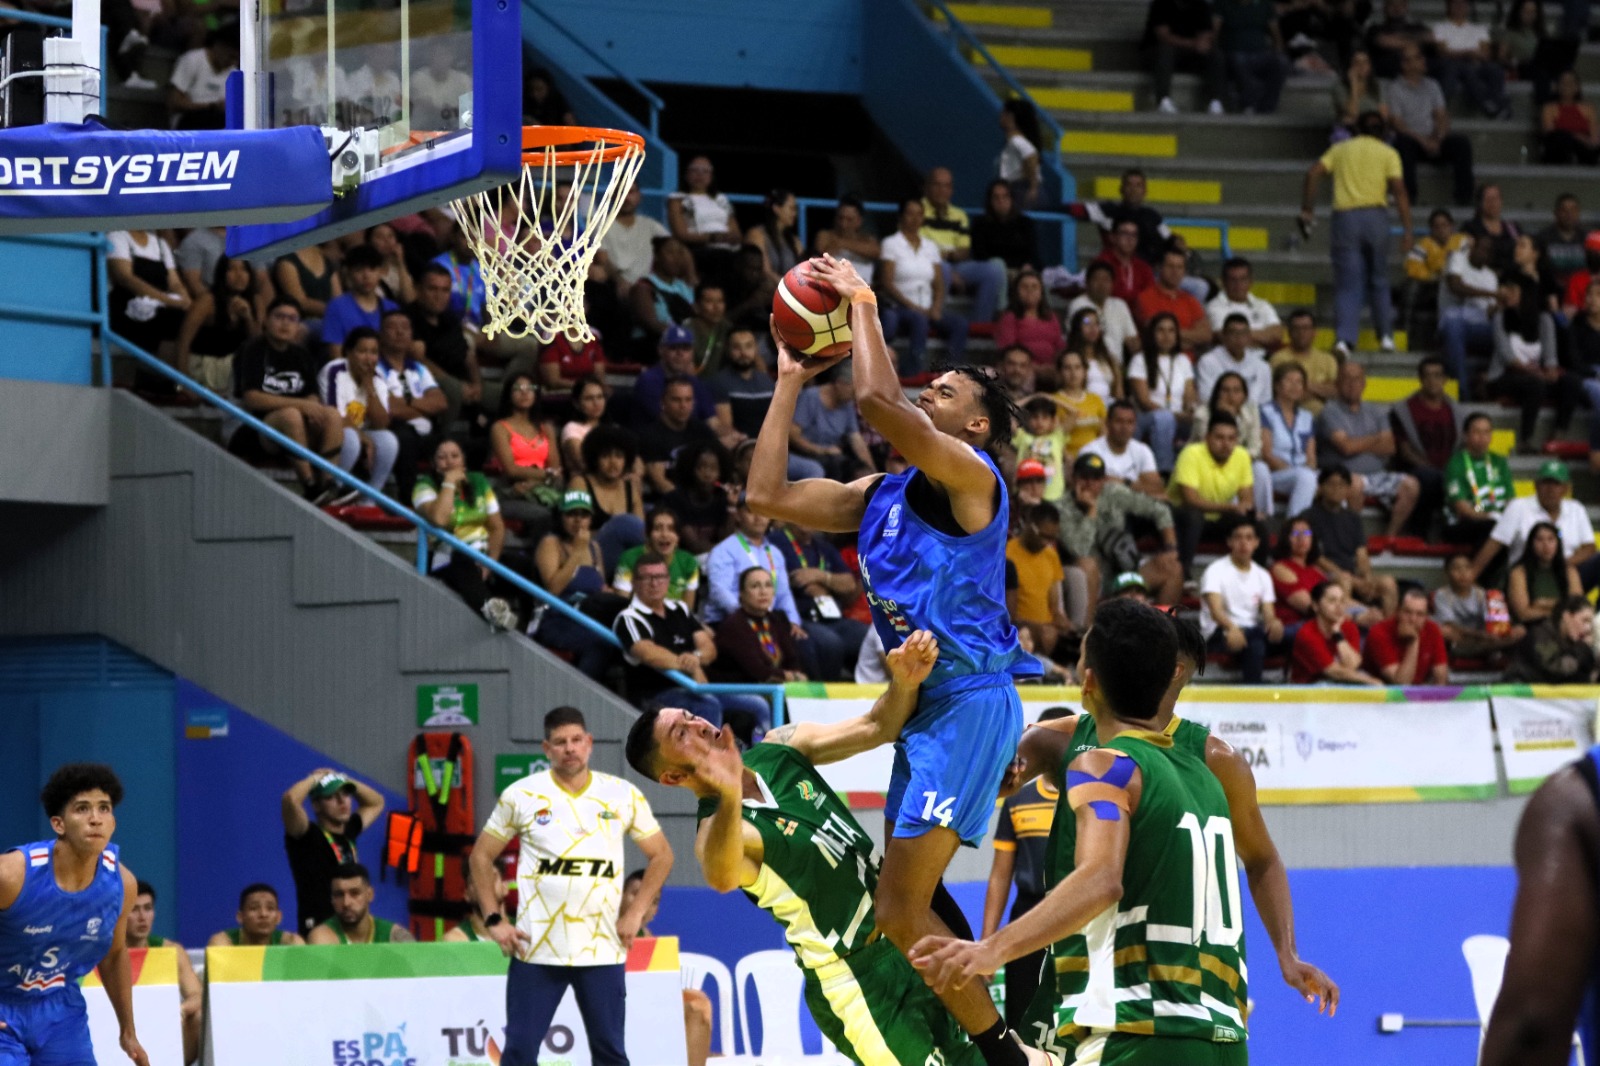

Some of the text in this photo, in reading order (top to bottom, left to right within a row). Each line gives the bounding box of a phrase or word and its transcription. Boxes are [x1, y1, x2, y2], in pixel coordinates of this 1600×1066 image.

[921, 791, 957, 828] 14
[537, 858, 615, 879] META
[1176, 811, 1243, 947] 10
[441, 1019, 489, 1057] TÚ
